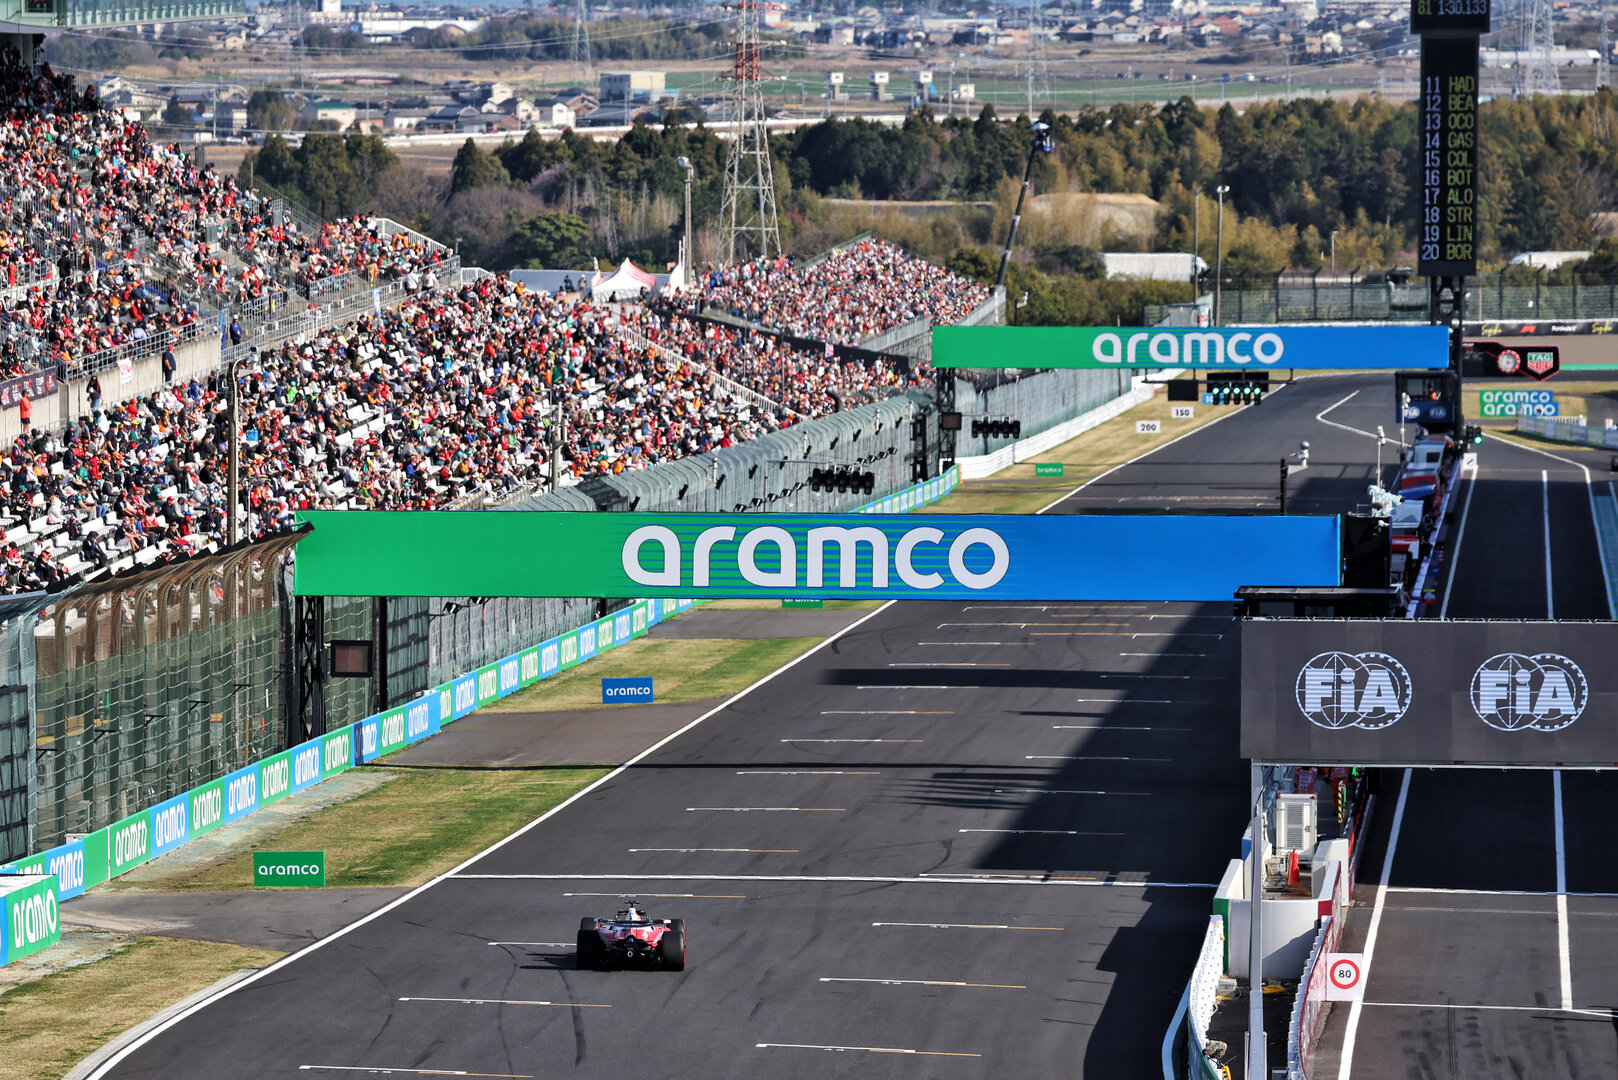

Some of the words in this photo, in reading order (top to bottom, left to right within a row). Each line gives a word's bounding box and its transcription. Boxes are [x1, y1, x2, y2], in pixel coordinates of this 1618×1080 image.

[1418, 0, 1432, 15] 81
[1426, 76, 1440, 93] 11
[1448, 76, 1474, 93] HAD
[1426, 94, 1441, 111] 12
[1448, 94, 1474, 111] BEA
[1425, 113, 1440, 130] 13
[1448, 113, 1474, 129] OCO
[1425, 132, 1440, 149] 14
[1448, 131, 1474, 148] GAS
[1425, 150, 1440, 167] 15
[1448, 150, 1472, 167] COL
[1424, 169, 1440, 186] 16
[1448, 169, 1472, 186] BOT
[1424, 188, 1440, 205] 17
[1448, 188, 1473, 205] ALO
[1424, 206, 1440, 223] 18
[1448, 206, 1472, 223] STR
[1424, 225, 1440, 242] 19
[1448, 225, 1472, 242] LIN
[1422, 244, 1439, 260] 20
[1447, 244, 1472, 260] BOR
[1092, 332, 1284, 364] aramco
[1528, 361, 1553, 370] HEUER
[1531, 353, 1551, 361] TAG
[1482, 391, 1550, 403] aramco
[1141, 424, 1156, 432] 200
[621, 524, 1010, 590] aramco
[606, 687, 651, 696] aramco
[382, 712, 404, 748] aramco
[325, 734, 349, 771] aramco
[295, 746, 319, 786] aramco
[262, 758, 288, 799] aramco
[229, 772, 256, 814] aramco
[193, 788, 221, 830] aramco
[156, 802, 185, 848] aramco
[115, 819, 147, 867] aramco
[258, 865, 319, 875] aramco
[13, 888, 57, 949] aramo
[1339, 970, 1351, 978] 80
